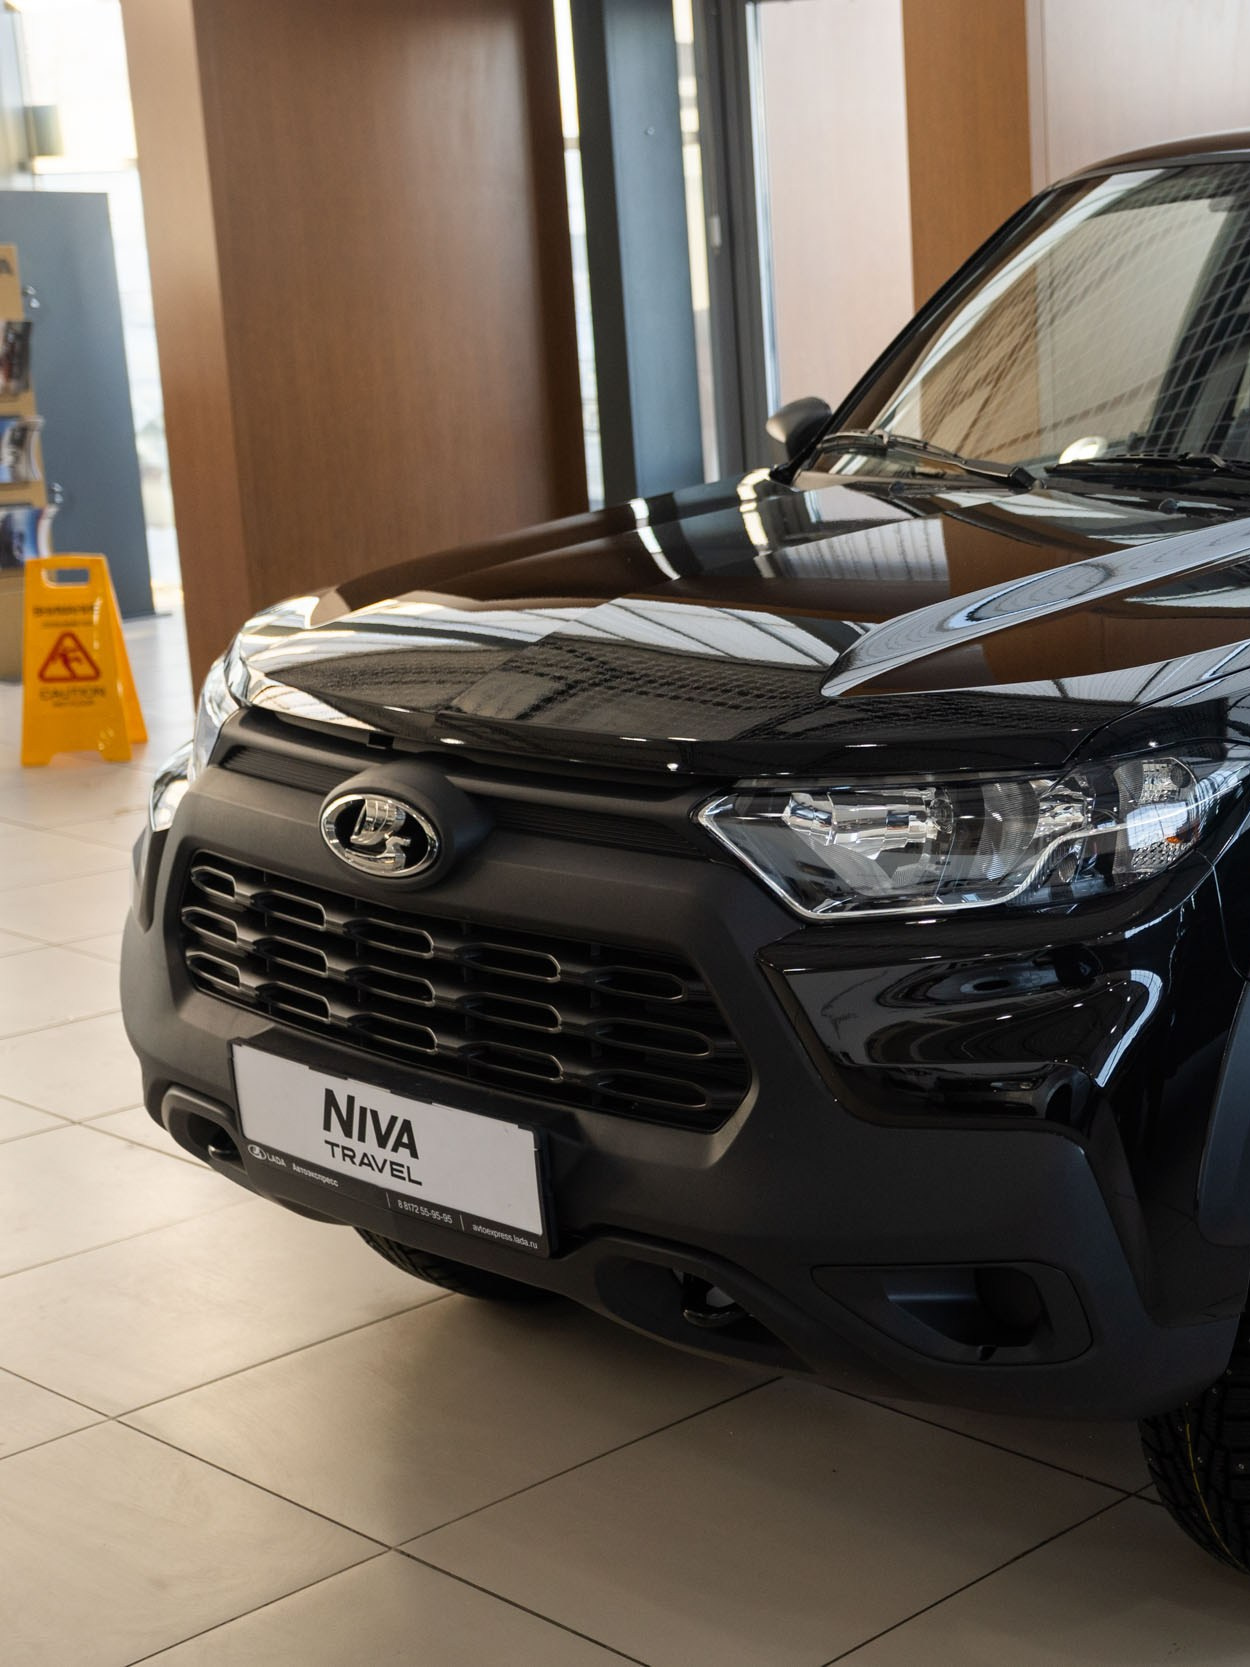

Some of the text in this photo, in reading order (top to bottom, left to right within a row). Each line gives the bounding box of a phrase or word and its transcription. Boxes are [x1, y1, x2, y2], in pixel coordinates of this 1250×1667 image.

[322, 1088, 419, 1160] NIVA
[267, 1153, 286, 1167] LADA
[324, 1140, 423, 1186] TRAVEL
[420, 1208, 453, 1224] 55-95-95
[472, 1223, 539, 1249] avtoexpress.lada.ru
